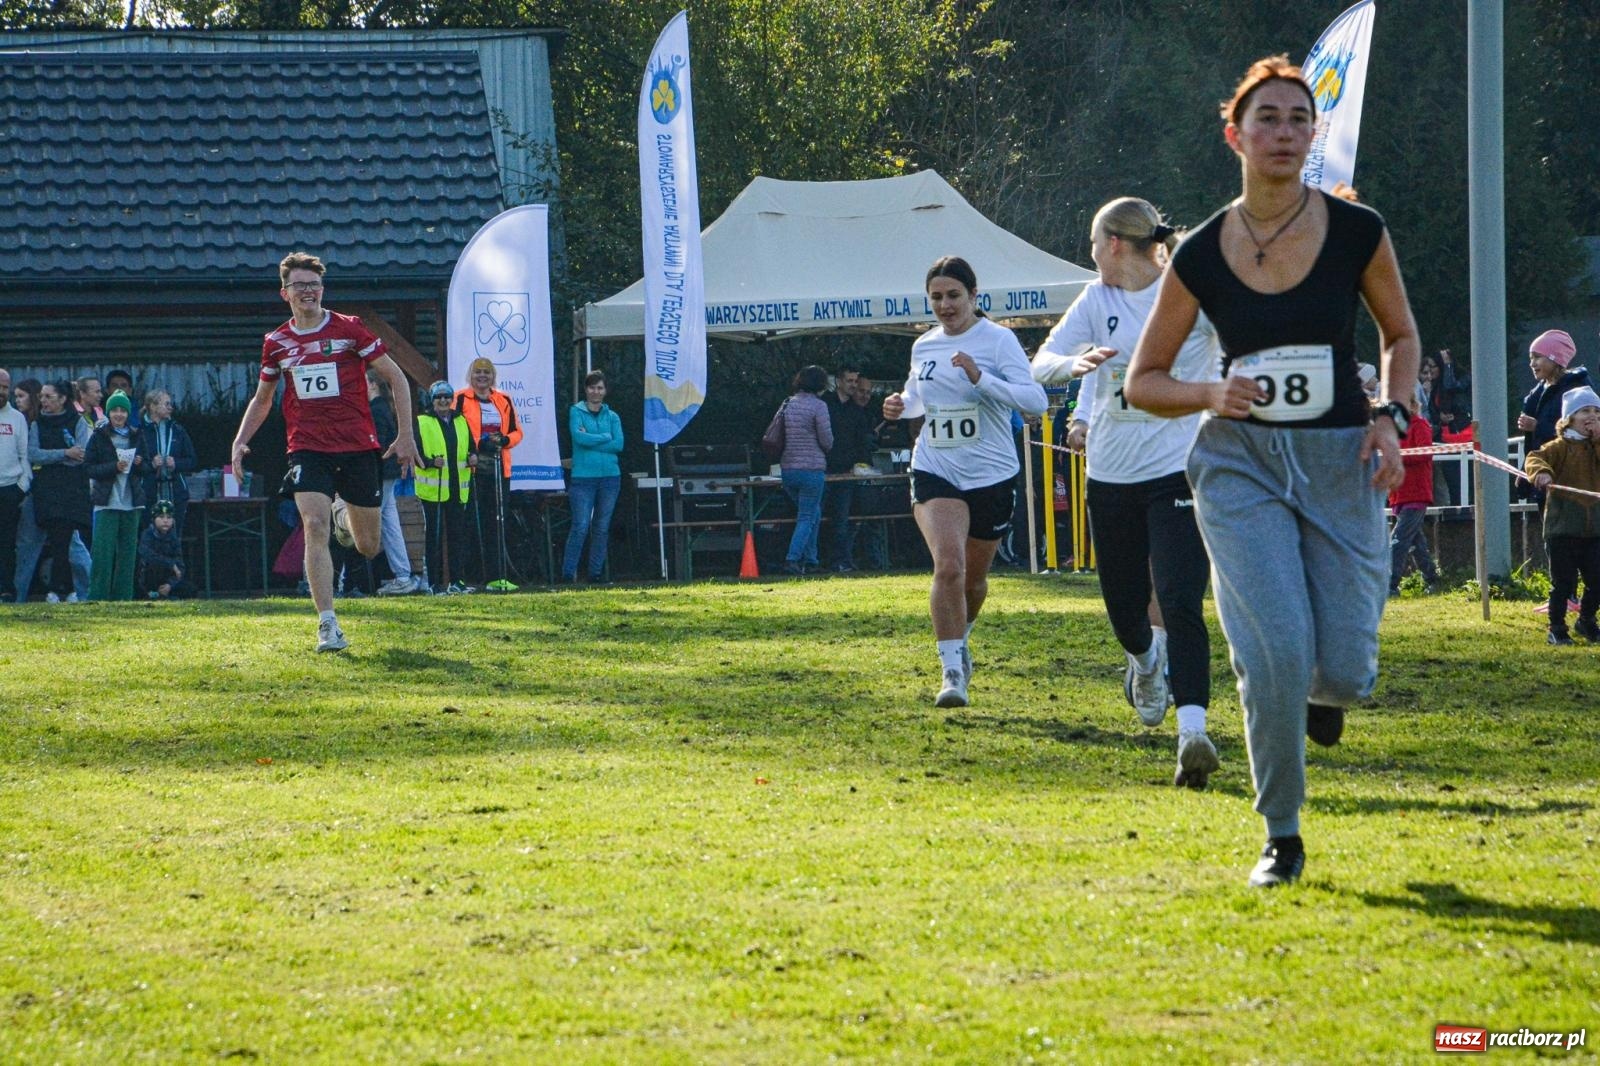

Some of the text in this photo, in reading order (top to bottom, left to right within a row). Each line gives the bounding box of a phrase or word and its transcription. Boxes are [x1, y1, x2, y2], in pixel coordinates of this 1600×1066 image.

[813, 299, 872, 320] AKTYWNI
[886, 297, 911, 317] DLA
[1005, 290, 1048, 311] JUTRA
[1107, 316, 1119, 337] 9
[918, 360, 937, 381] 22
[302, 376, 328, 393] 76
[1253, 373, 1310, 407] 98
[928, 418, 976, 439] 110
